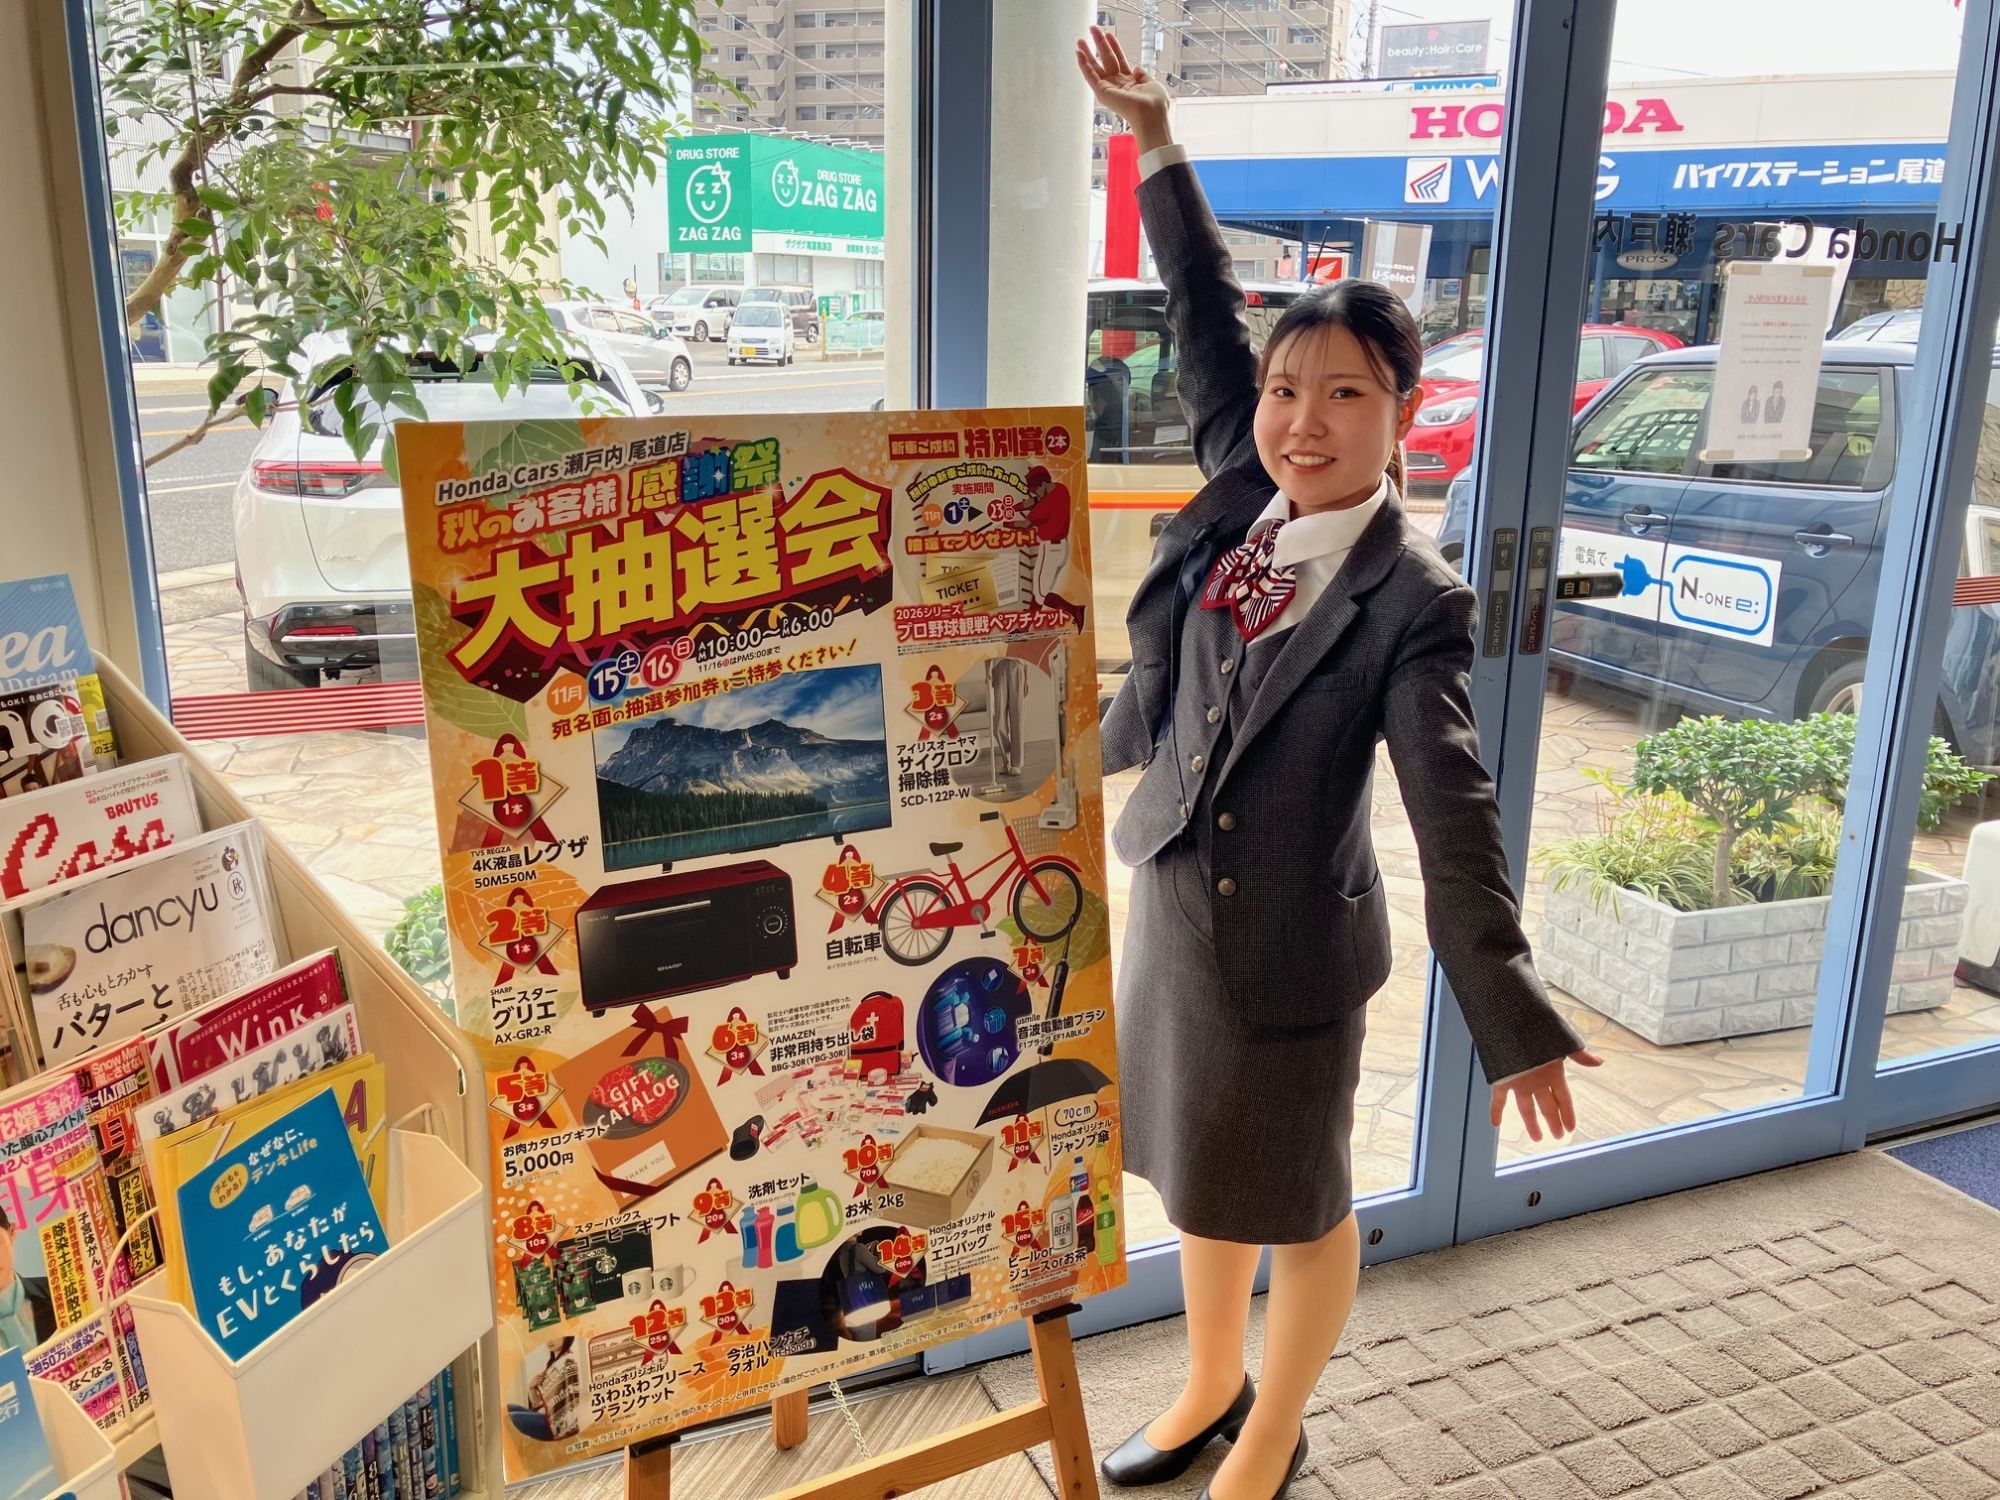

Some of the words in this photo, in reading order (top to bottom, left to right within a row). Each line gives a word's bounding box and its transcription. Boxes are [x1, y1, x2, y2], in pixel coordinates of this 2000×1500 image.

[676, 148, 703, 160] DRUG
[706, 147, 740, 159] STORE
[816, 168, 838, 183] DRUG
[838, 171, 863, 185] STORE
[801, 180, 838, 209] ZAG
[842, 183, 877, 213] ZAG
[678, 227, 708, 241] ZAG
[711, 226, 741, 241] ZAG
[1372, 270, 1417, 284] U-Select
[964, 426, 1045, 458] 特別賞
[1047, 435, 1067, 449] 2本
[437, 474, 509, 503] Honda
[512, 464, 560, 491] Cars
[563, 442, 625, 478] 瀬戸内
[627, 432, 688, 466] 尾道店
[952, 482, 995, 495] 実施期間
[455, 471, 883, 669] 大抽選会
[1574, 545, 1608, 567] 電気で
[936, 577, 980, 601] TICKET
[1563, 580, 1590, 596] 自動
[1680, 575, 1733, 609] N-ONE
[896, 604, 962, 620] 2026シリーズ
[897, 610, 1070, 641] プロ野球観戦ペアチケット
[551, 683, 583, 705] 11月
[911, 682, 955, 711] 3等
[896, 736, 977, 756] アイリスオーヤマ
[898, 748, 979, 773] サイクロン
[471, 759, 538, 801] 1等
[898, 767, 951, 792] 掃除機
[104, 792, 160, 820] BRUTUS
[901, 787, 971, 808] SCD-122P-W
[474, 869, 537, 889] 50M550M
[822, 863, 873, 894] 4等
[84, 882, 220, 955] dancyu
[485, 908, 547, 945] 2等
[826, 931, 883, 961] 自転車
[490, 986, 513, 996] SHARP
[491, 986, 559, 1009] トースター
[52, 982, 174, 1050] バターと
[492, 1001, 558, 1030] グリエ
[1016, 1013, 1041, 1025] usmile
[1016, 1009, 1106, 1040] 音波電動歯ブラシ
[494, 1024, 552, 1045] AX-GR2-R
[711, 1022, 757, 1052] 6等
[769, 1029, 816, 1046] YAMAZEN
[770, 1026, 876, 1062] 非常用持ち出し袋
[91, 1054, 119, 1074] Snow
[496, 1072, 547, 1103] 5等
[609, 1070, 651, 1103] GIFT
[597, 1073, 680, 1130] CATALOG
[1063, 1105, 1092, 1120] 70cm
[503, 1125, 606, 1158] お肉カタログギフト
[1000, 1121, 1044, 1145] 11等
[1051, 1119, 1112, 1142] Hondaオリジナル
[1051, 1130, 1110, 1157] ジャンプ傘
[251, 1137, 319, 1185] デンキLife
[504, 1150, 574, 1178] 5,000円
[748, 1173, 810, 1200] 洗剤セット
[845, 1199, 873, 1219] お米
[877, 1193, 905, 1211] 2kg
[574, 1210, 642, 1236] スターバックス
[576, 1211, 681, 1251] コーヒーギフト
[928, 1211, 996, 1236] Hondaオリジナル
[929, 1221, 993, 1249] リフレクター付き
[1053, 1222, 1071, 1237] BEER
[931, 1234, 989, 1262] エコバッグ
[1008, 1248, 1087, 1283] ジュースorお茶
[215, 1220, 376, 1340] EVとくらしたら
[726, 1326, 810, 1363] 今治ハンカチ
[588, 1362, 666, 1392] Hondaオリジナル
[728, 1354, 770, 1378] タオル
[591, 1361, 707, 1407] ふわふわフリース
[592, 1388, 675, 1423] ブランケット
